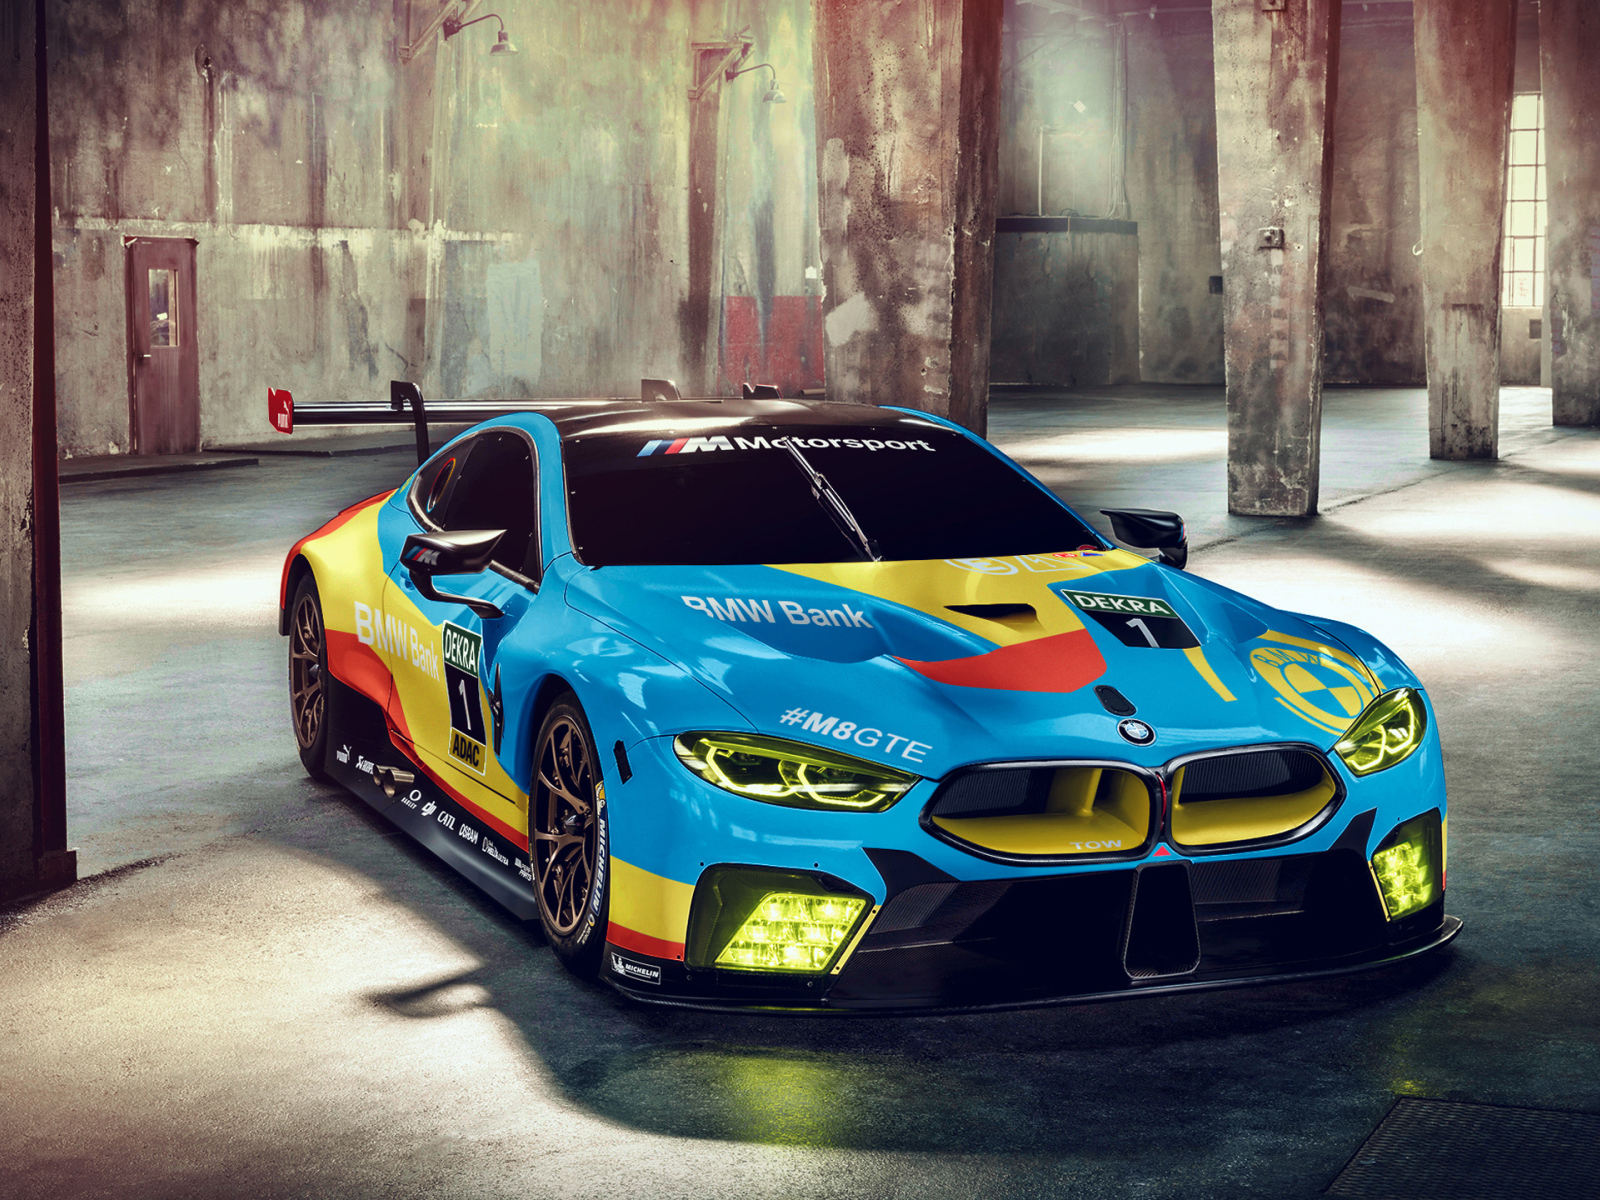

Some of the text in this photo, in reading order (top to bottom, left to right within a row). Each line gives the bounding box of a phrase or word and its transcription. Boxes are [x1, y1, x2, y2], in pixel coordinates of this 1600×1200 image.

[733, 436, 936, 452] Motorsport
[681, 596, 874, 629] BMW Bank
[1074, 593, 1170, 615] DEKRA
[354, 601, 439, 682] BMW Bank
[1126, 617, 1160, 648] 1
[444, 628, 477, 673] DEKRA
[1253, 648, 1322, 669] BMW
[458, 679, 472, 731] 1
[453, 733, 480, 768] ADAC
[779, 707, 933, 763] #M8GTE
[437, 810, 456, 831] CATL
[458, 823, 479, 845] OSRAM
[1069, 839, 1122, 850] TOW
[593, 818, 606, 911] MICHELIN
[625, 963, 659, 978] MICHELIN
